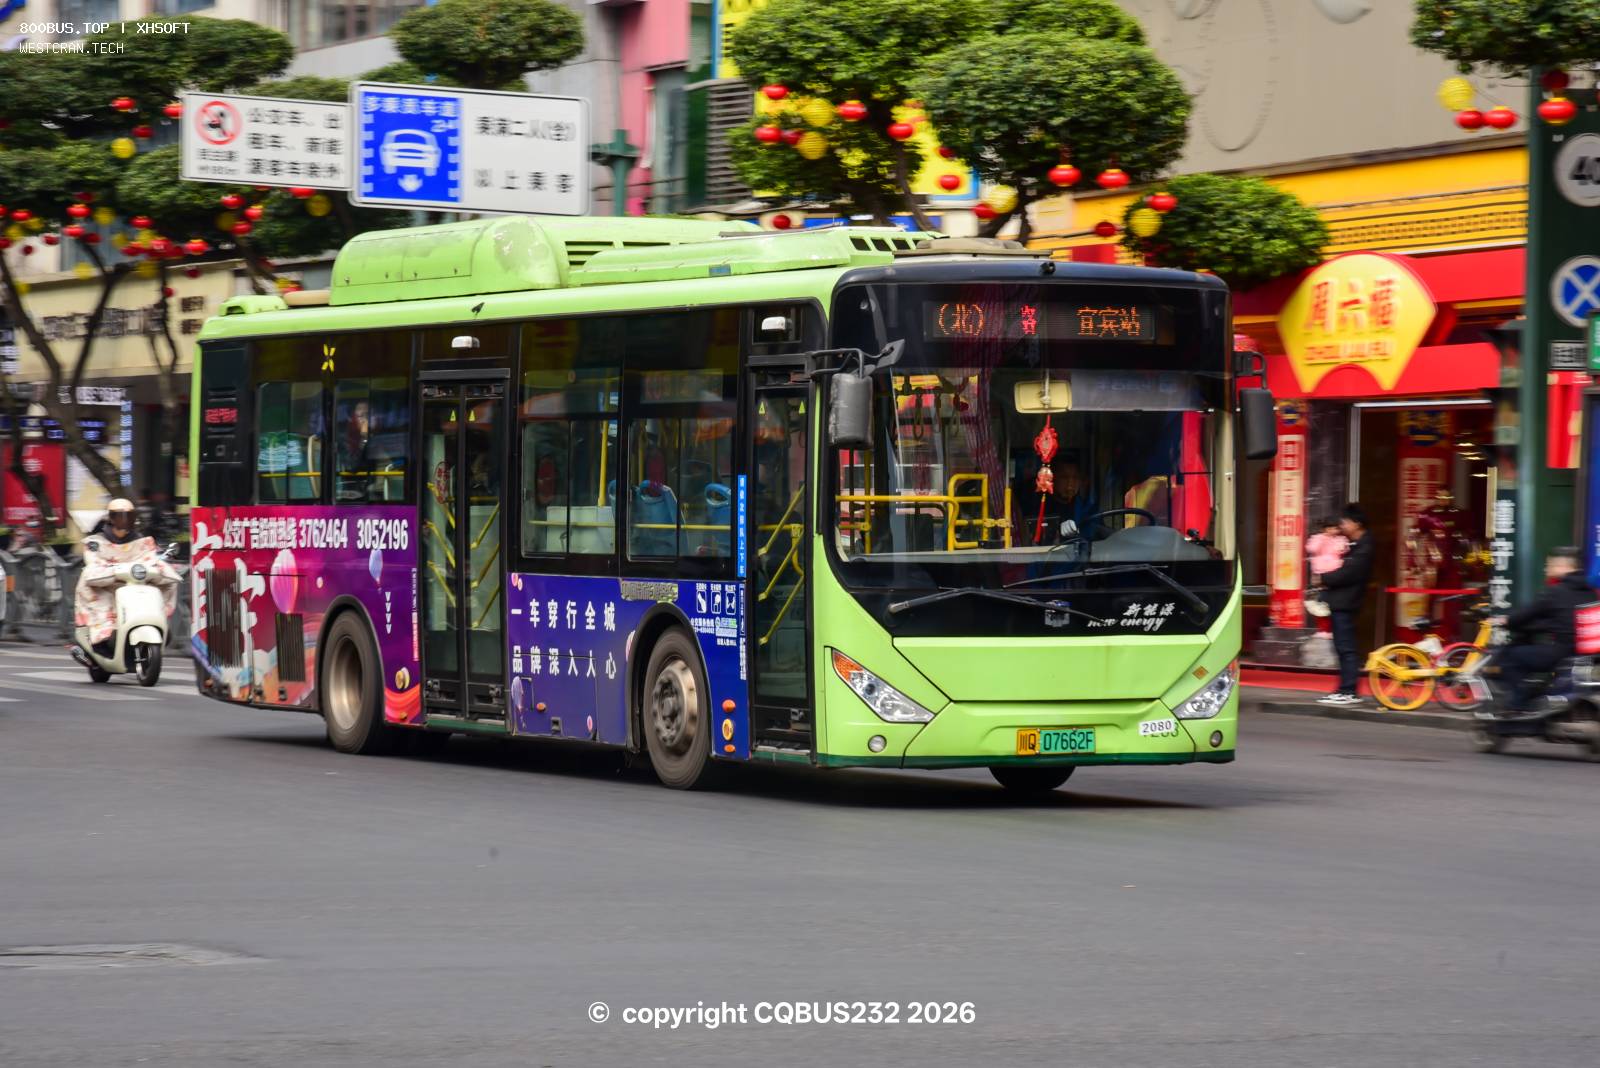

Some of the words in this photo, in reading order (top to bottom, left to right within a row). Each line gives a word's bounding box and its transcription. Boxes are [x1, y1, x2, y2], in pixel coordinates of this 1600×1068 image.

[1076, 304, 1141, 337] 宜宾站
[299, 518, 348, 549] 3762464
[356, 518, 409, 550] 3052196
[511, 598, 616, 632] 一车穿行全城
[1123, 602, 1176, 617] 新能源
[1120, 616, 1167, 631] energy
[512, 645, 617, 680] 品牌深入人心
[1141, 721, 1172, 733] 2080
[1043, 733, 1094, 750] 07662F
